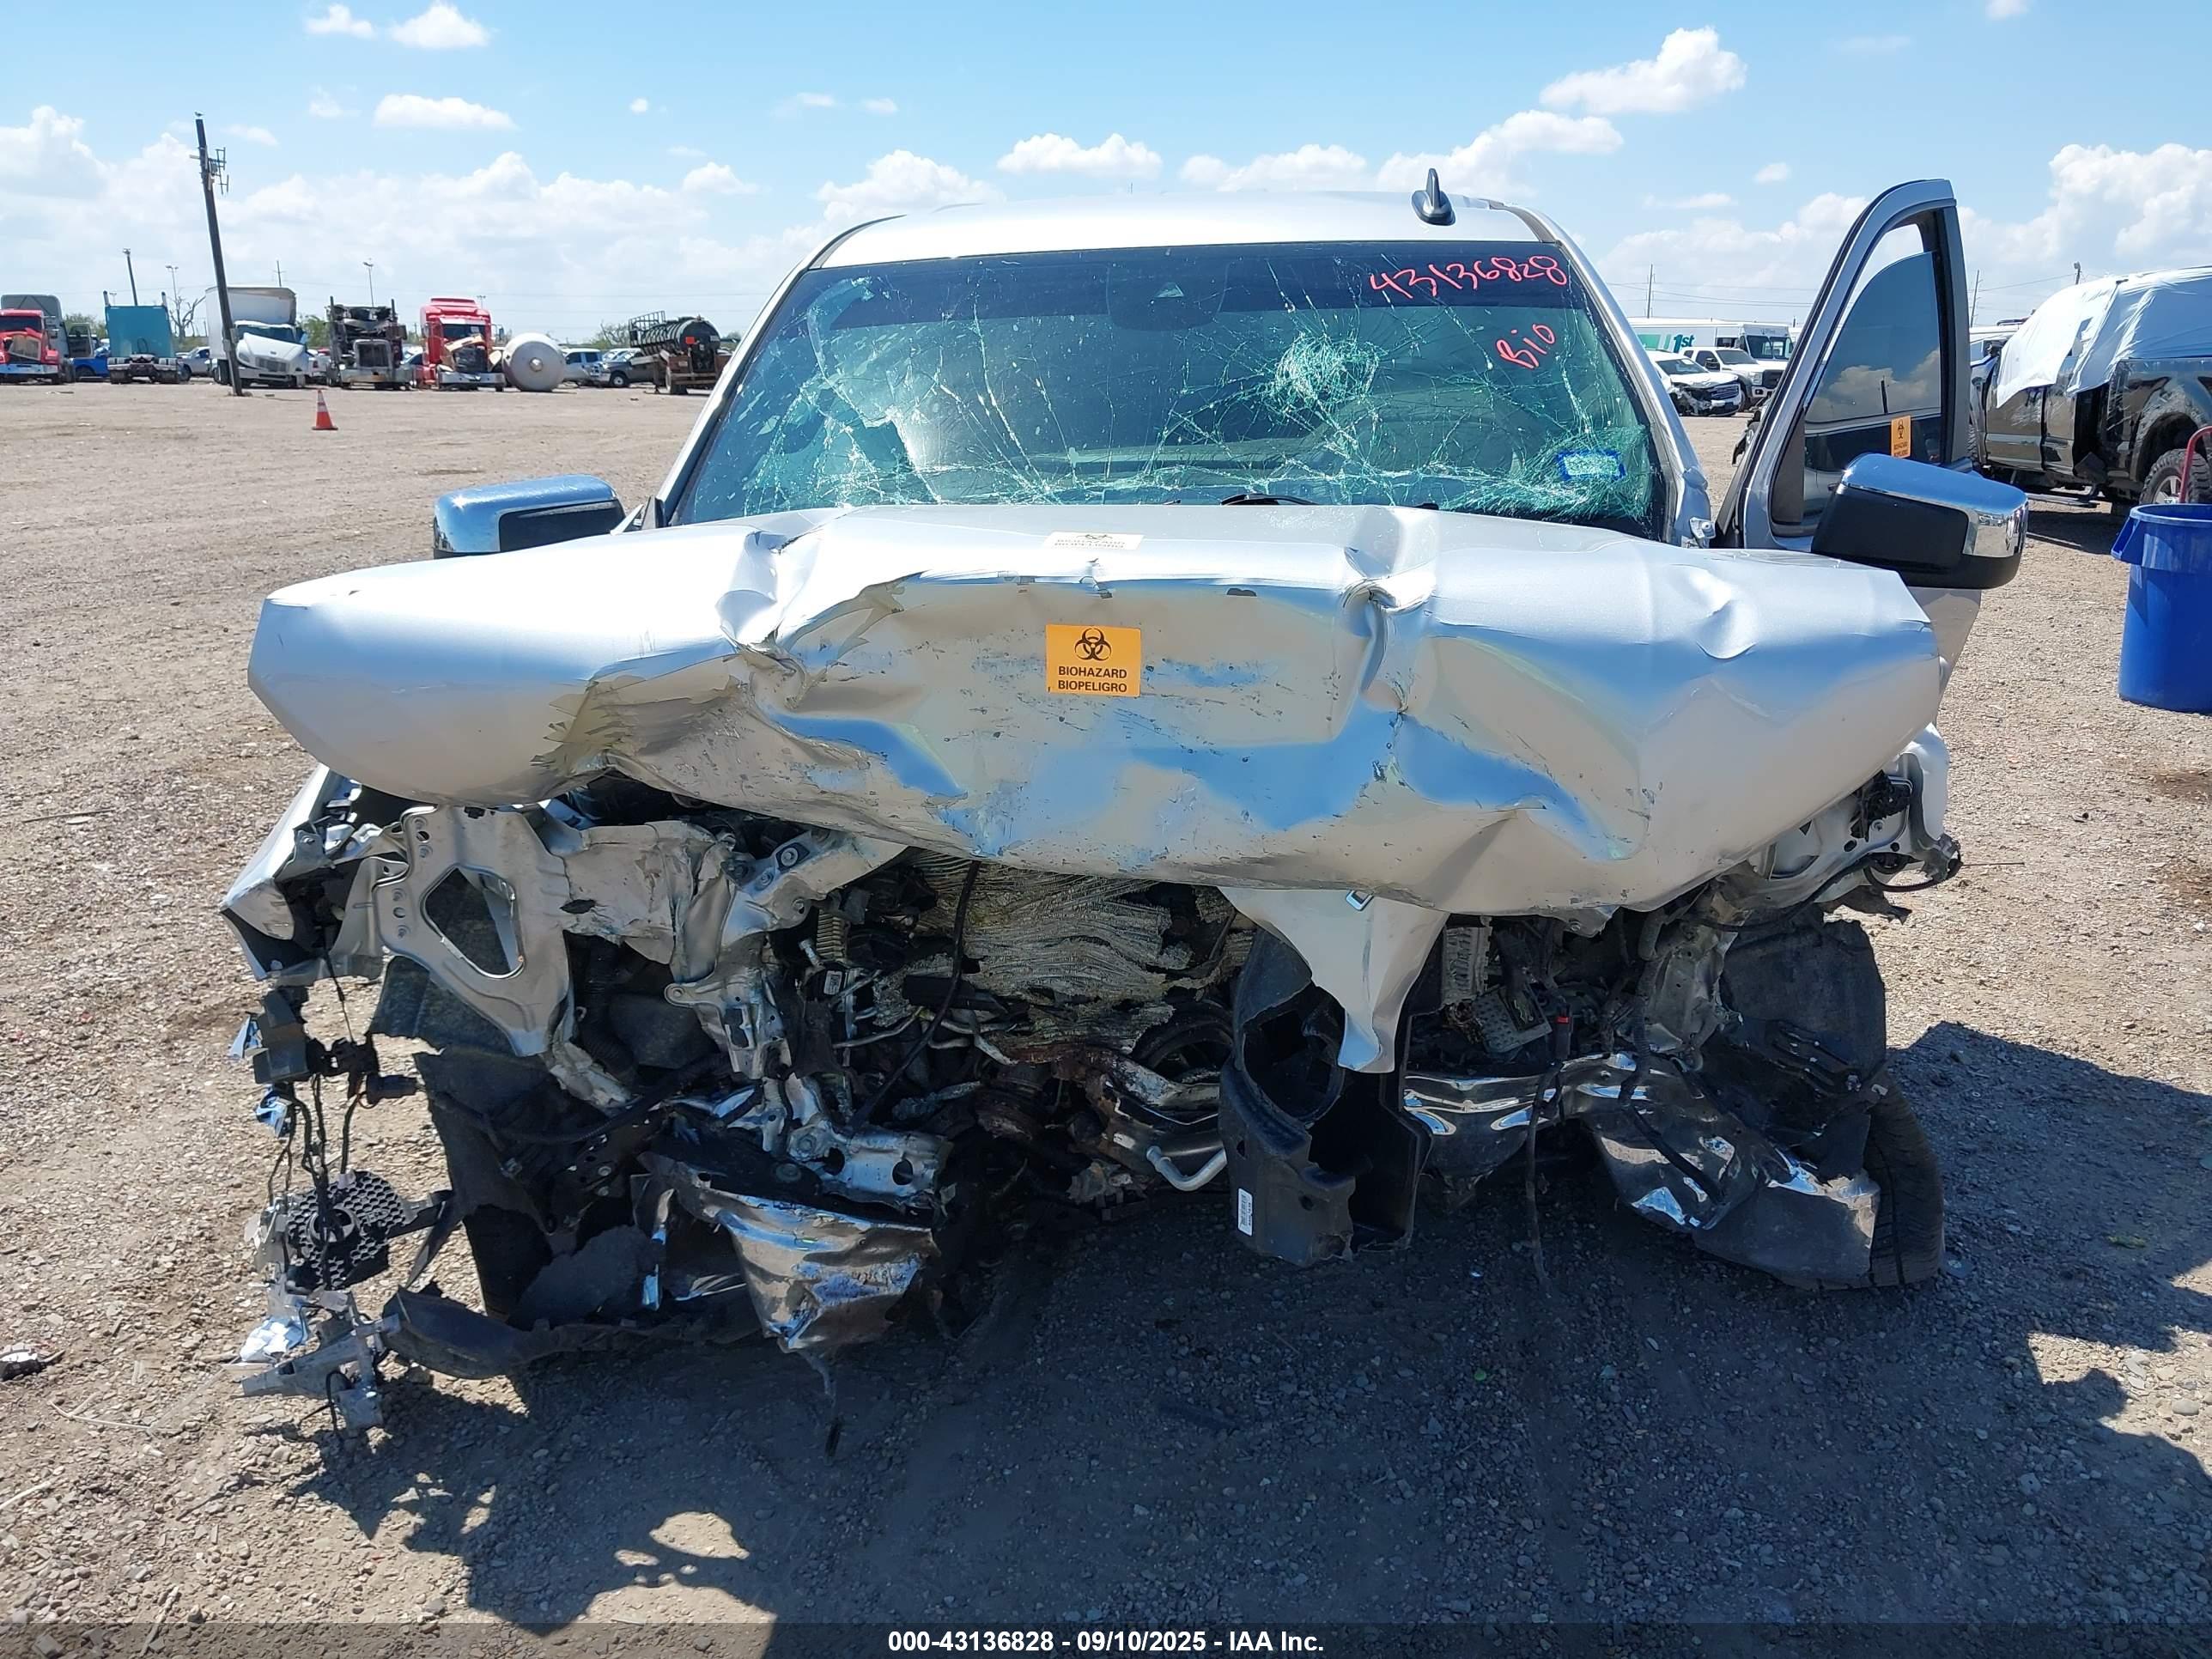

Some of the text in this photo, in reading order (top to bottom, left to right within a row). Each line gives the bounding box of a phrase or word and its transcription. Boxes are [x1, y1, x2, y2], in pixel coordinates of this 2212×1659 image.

[1369, 255, 1568, 300] 43136828
[1673, 334, 1695, 354] 1st
[1058, 665, 1127, 679] BIOHAZARD
[1058, 679, 1127, 693] BIOPELIGRO
